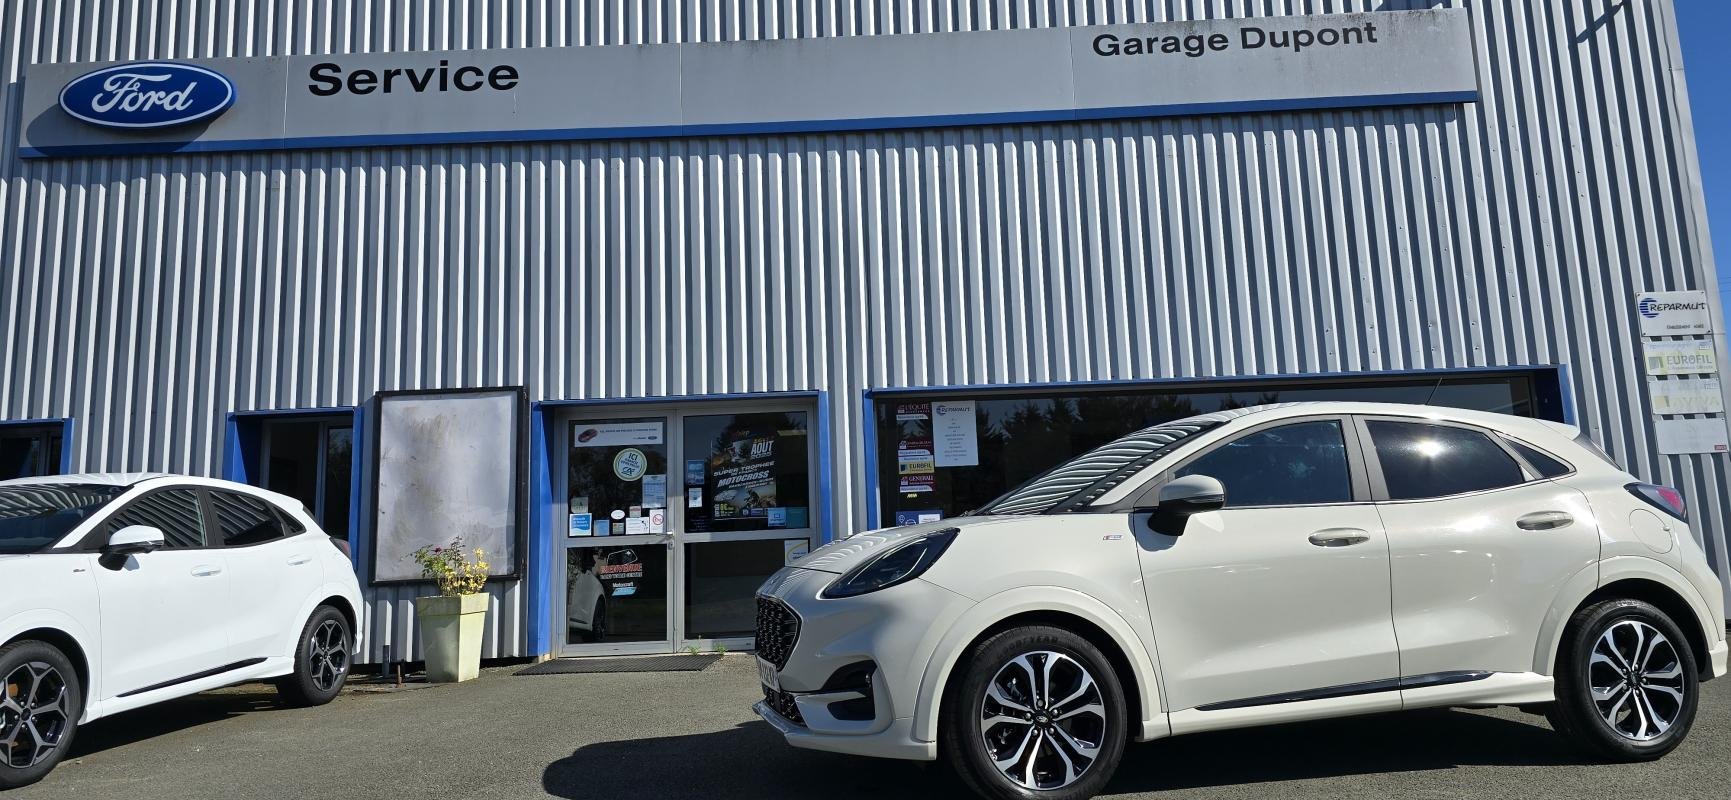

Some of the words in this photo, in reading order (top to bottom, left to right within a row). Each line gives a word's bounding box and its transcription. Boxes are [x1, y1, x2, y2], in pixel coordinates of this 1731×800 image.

[1092, 32, 1229, 58] Garage
[1240, 21, 1378, 53] Dupont
[307, 59, 520, 97] Service
[91, 73, 198, 113] Ford
[1649, 301, 1706, 312] REPARMUT
[1666, 354, 1713, 365] EUROFIL
[713, 467, 739, 477] SUPER
[717, 470, 771, 488] MOTOCROSS
